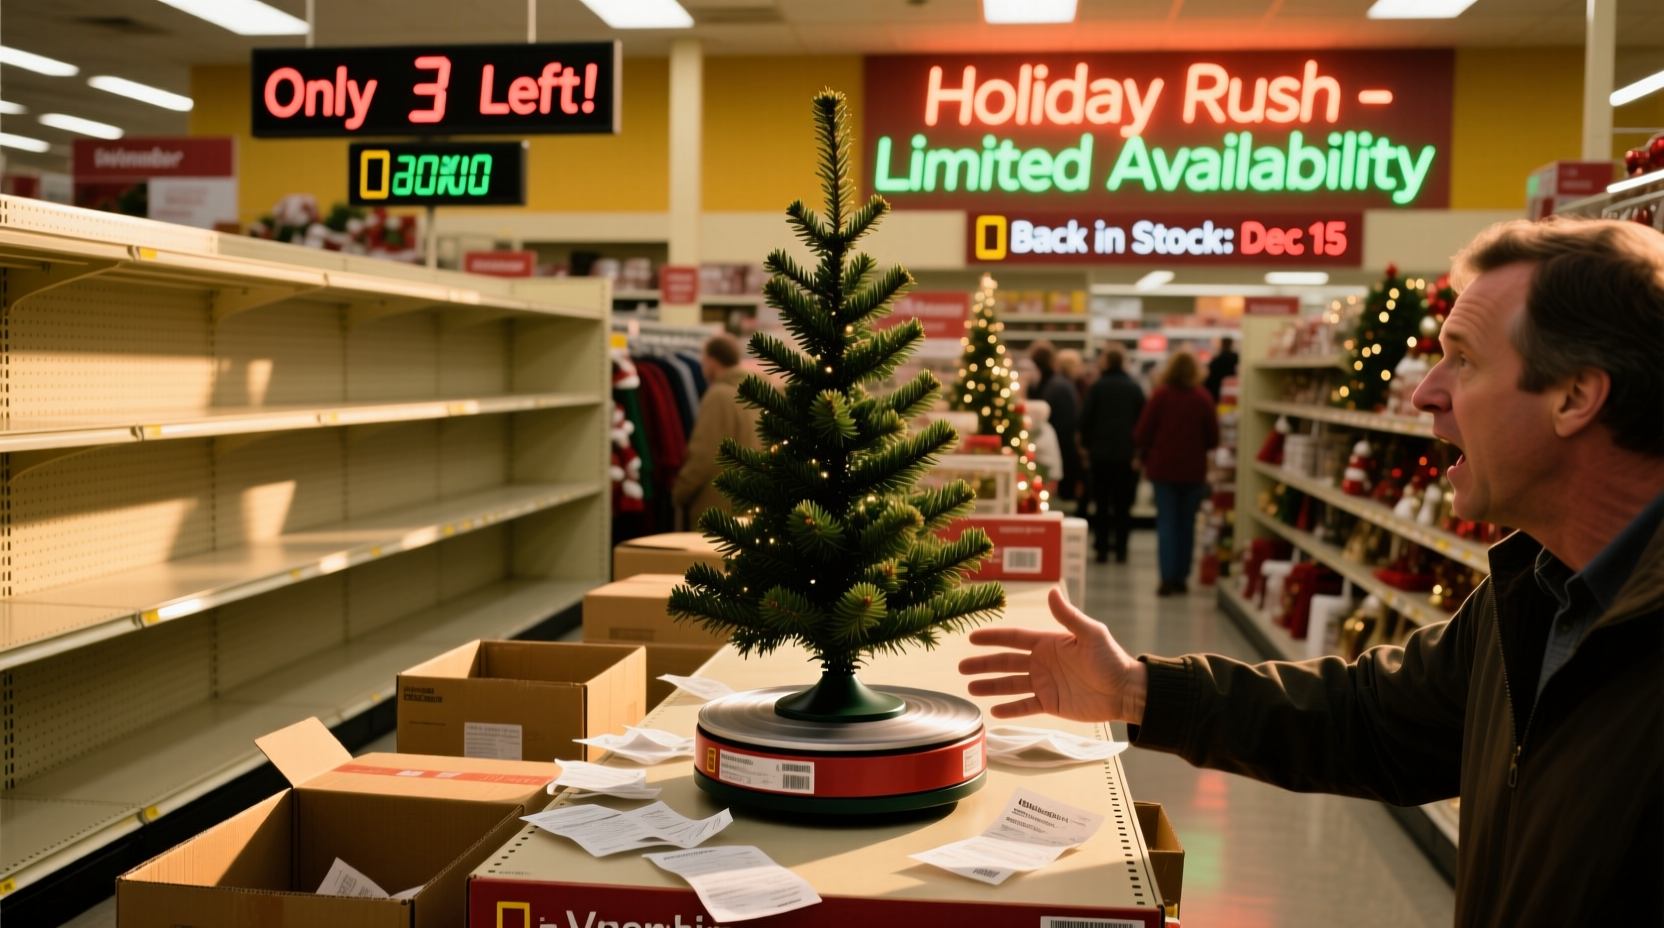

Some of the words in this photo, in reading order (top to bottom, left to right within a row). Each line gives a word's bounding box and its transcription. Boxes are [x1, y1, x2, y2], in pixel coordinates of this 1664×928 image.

[264, 65, 378, 131] Only
[408, 55, 452, 124] 3
[479, 61, 598, 115] Left!
[925, 61, 1165, 138] Holiday
[1182, 60, 1341, 124] Rush
[875, 133, 1094, 193] Limited
[1106, 131, 1436, 205] Availability
[1010, 220, 1088, 254] Back
[1094, 220, 1126, 254] in
[1131, 220, 1234, 255] Stock:
[1240, 220, 1303, 255] Dec
[1308, 220, 1347, 256] 15
